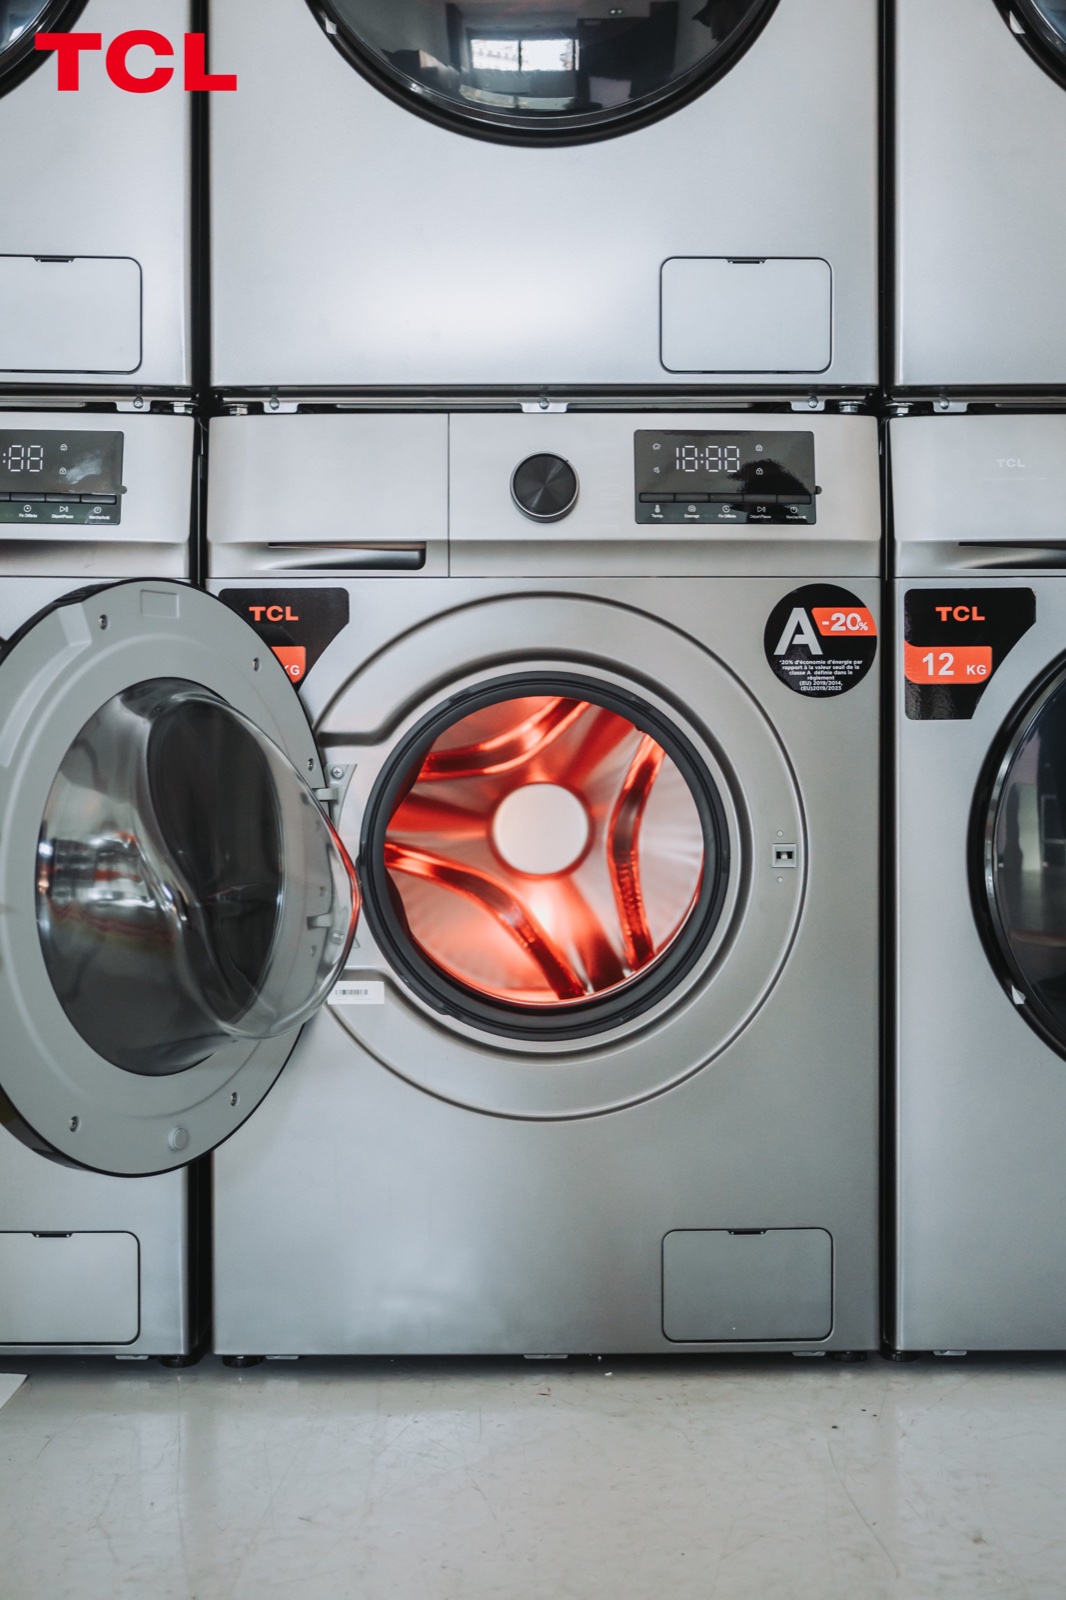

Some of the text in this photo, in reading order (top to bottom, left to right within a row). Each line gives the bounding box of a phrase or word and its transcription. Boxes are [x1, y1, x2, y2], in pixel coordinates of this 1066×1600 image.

[675, 445, 740, 473] 18:88
[995, 458, 1026, 468] TCL
[248, 605, 299, 622] TCL
[822, 612, 869, 632] -20%
[935, 605, 986, 622] TCL
[773, 607, 823, 656] A
[922, 652, 987, 676] 12 KG
